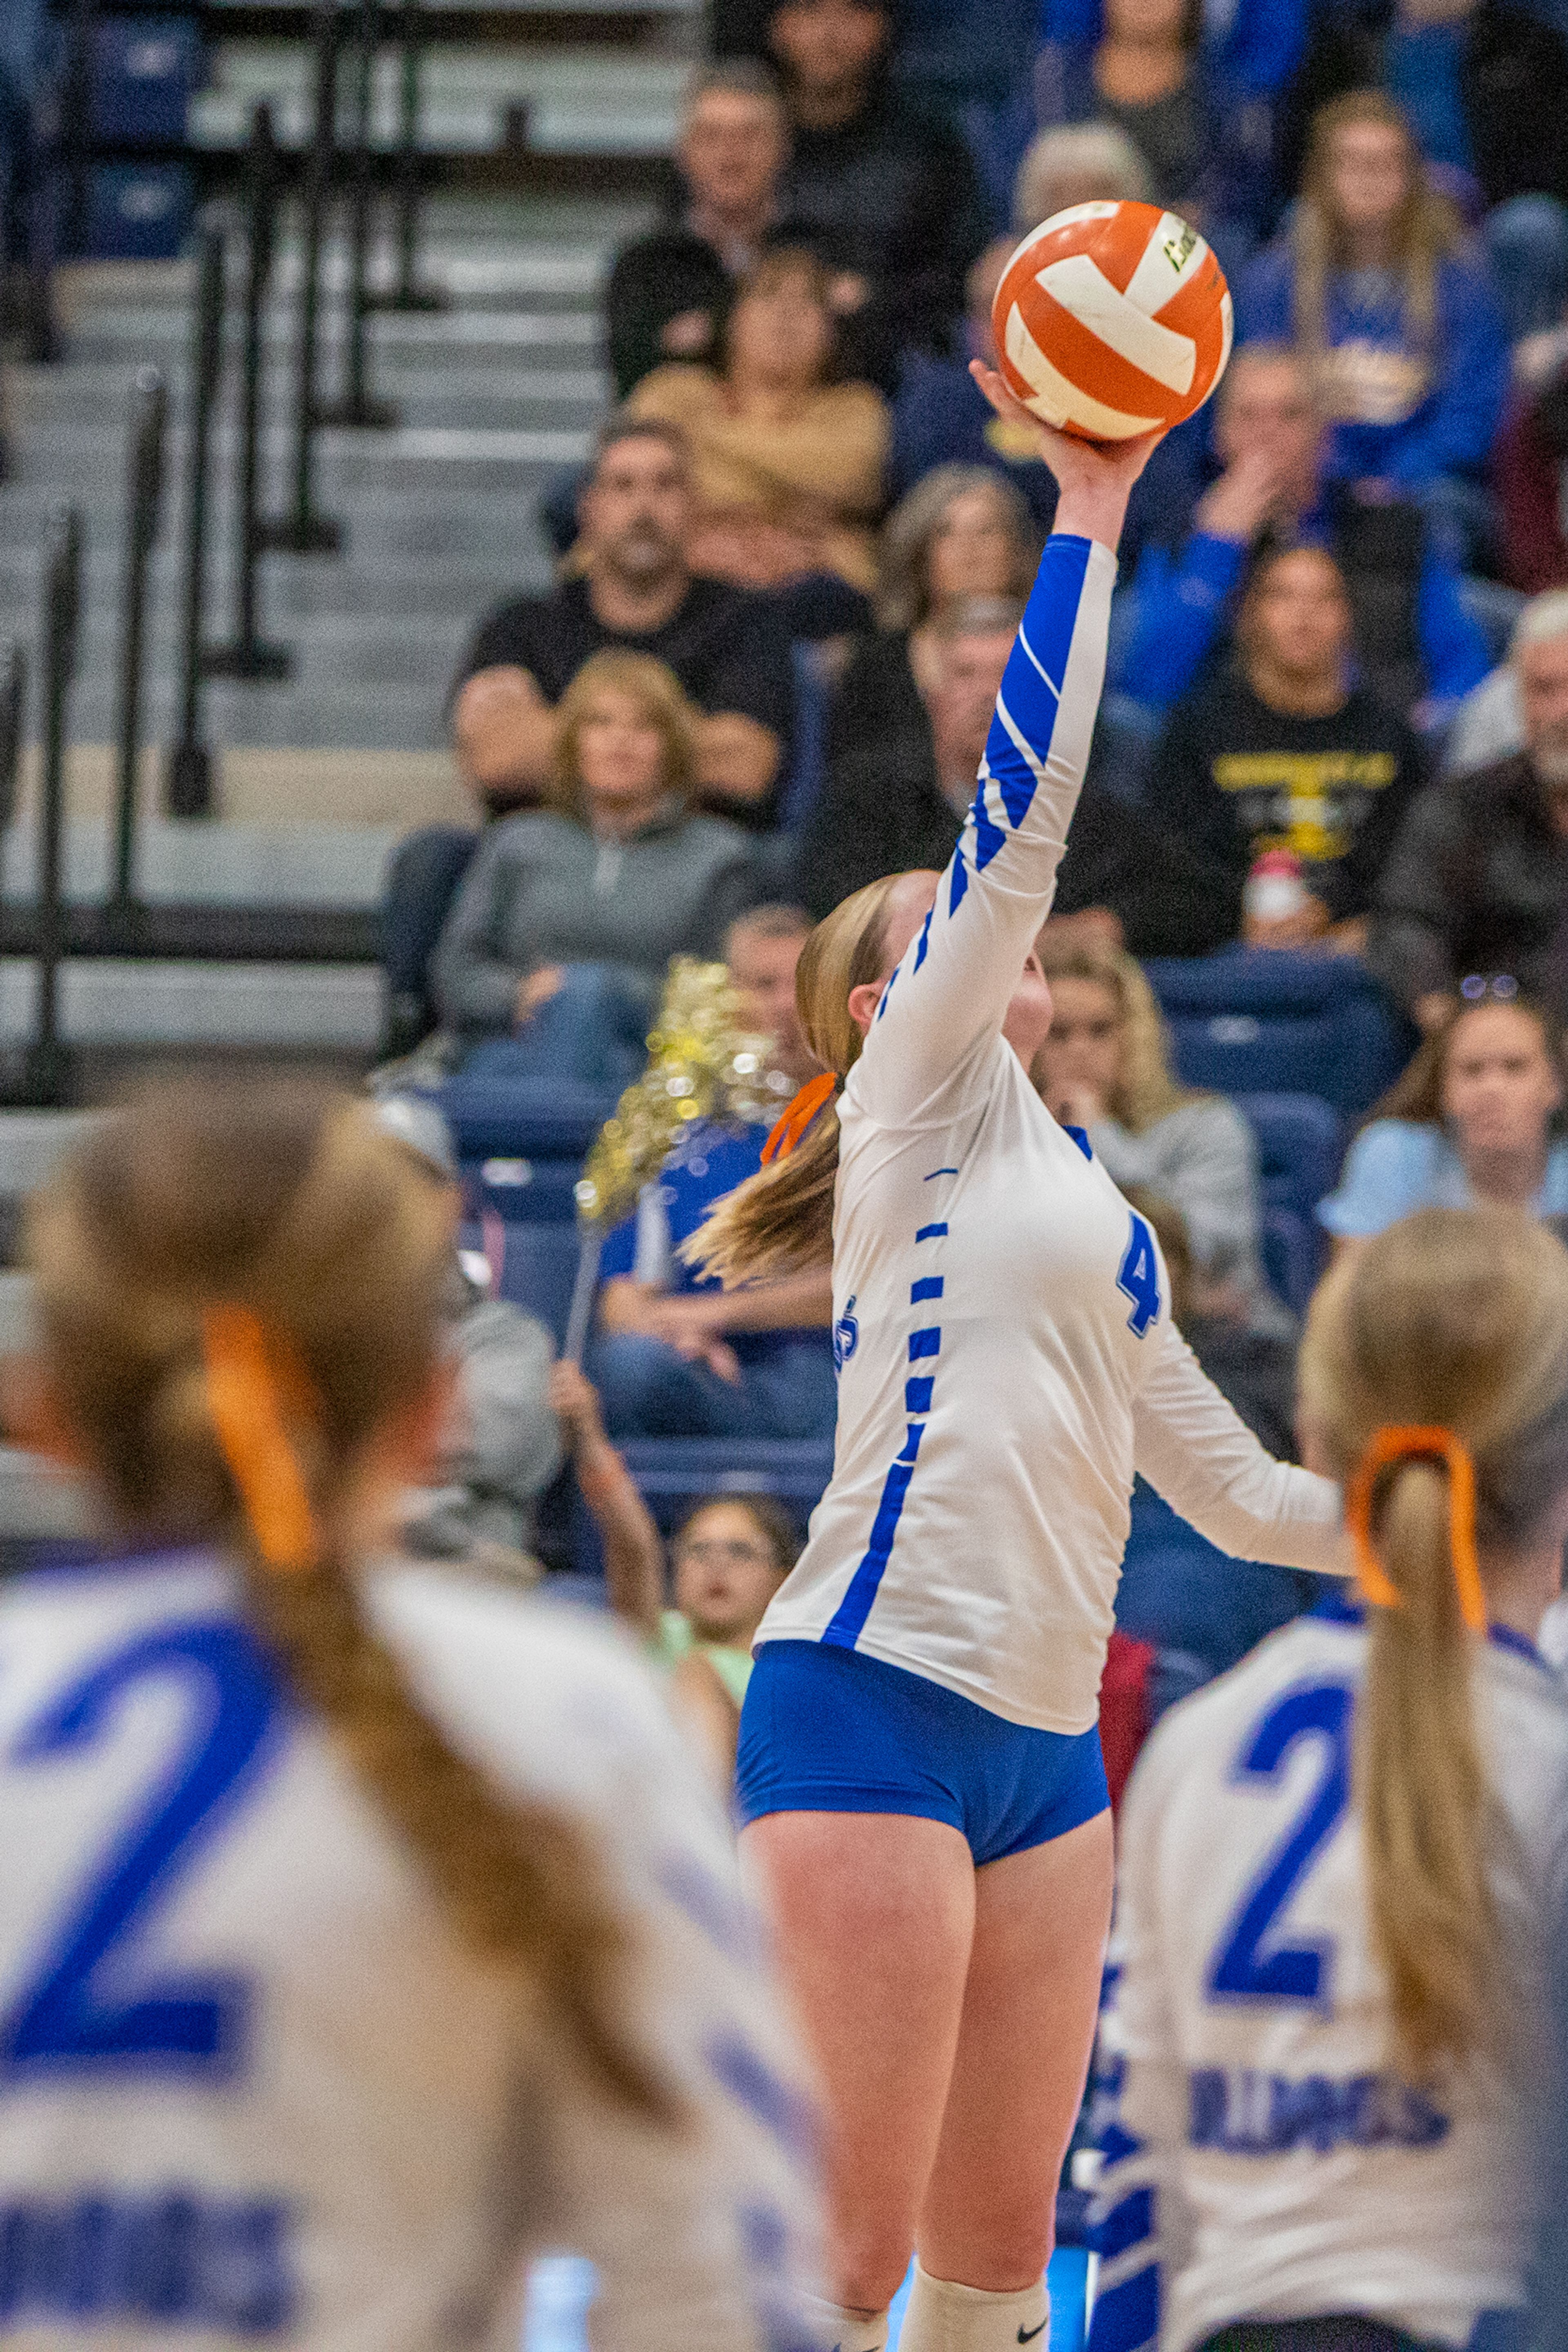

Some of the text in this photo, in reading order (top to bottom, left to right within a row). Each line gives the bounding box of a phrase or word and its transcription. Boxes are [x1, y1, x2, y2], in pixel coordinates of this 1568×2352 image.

[1117, 1211, 1162, 1340] 4
[0, 1613, 284, 2083] 2
[1207, 1676, 1358, 2003] 2
